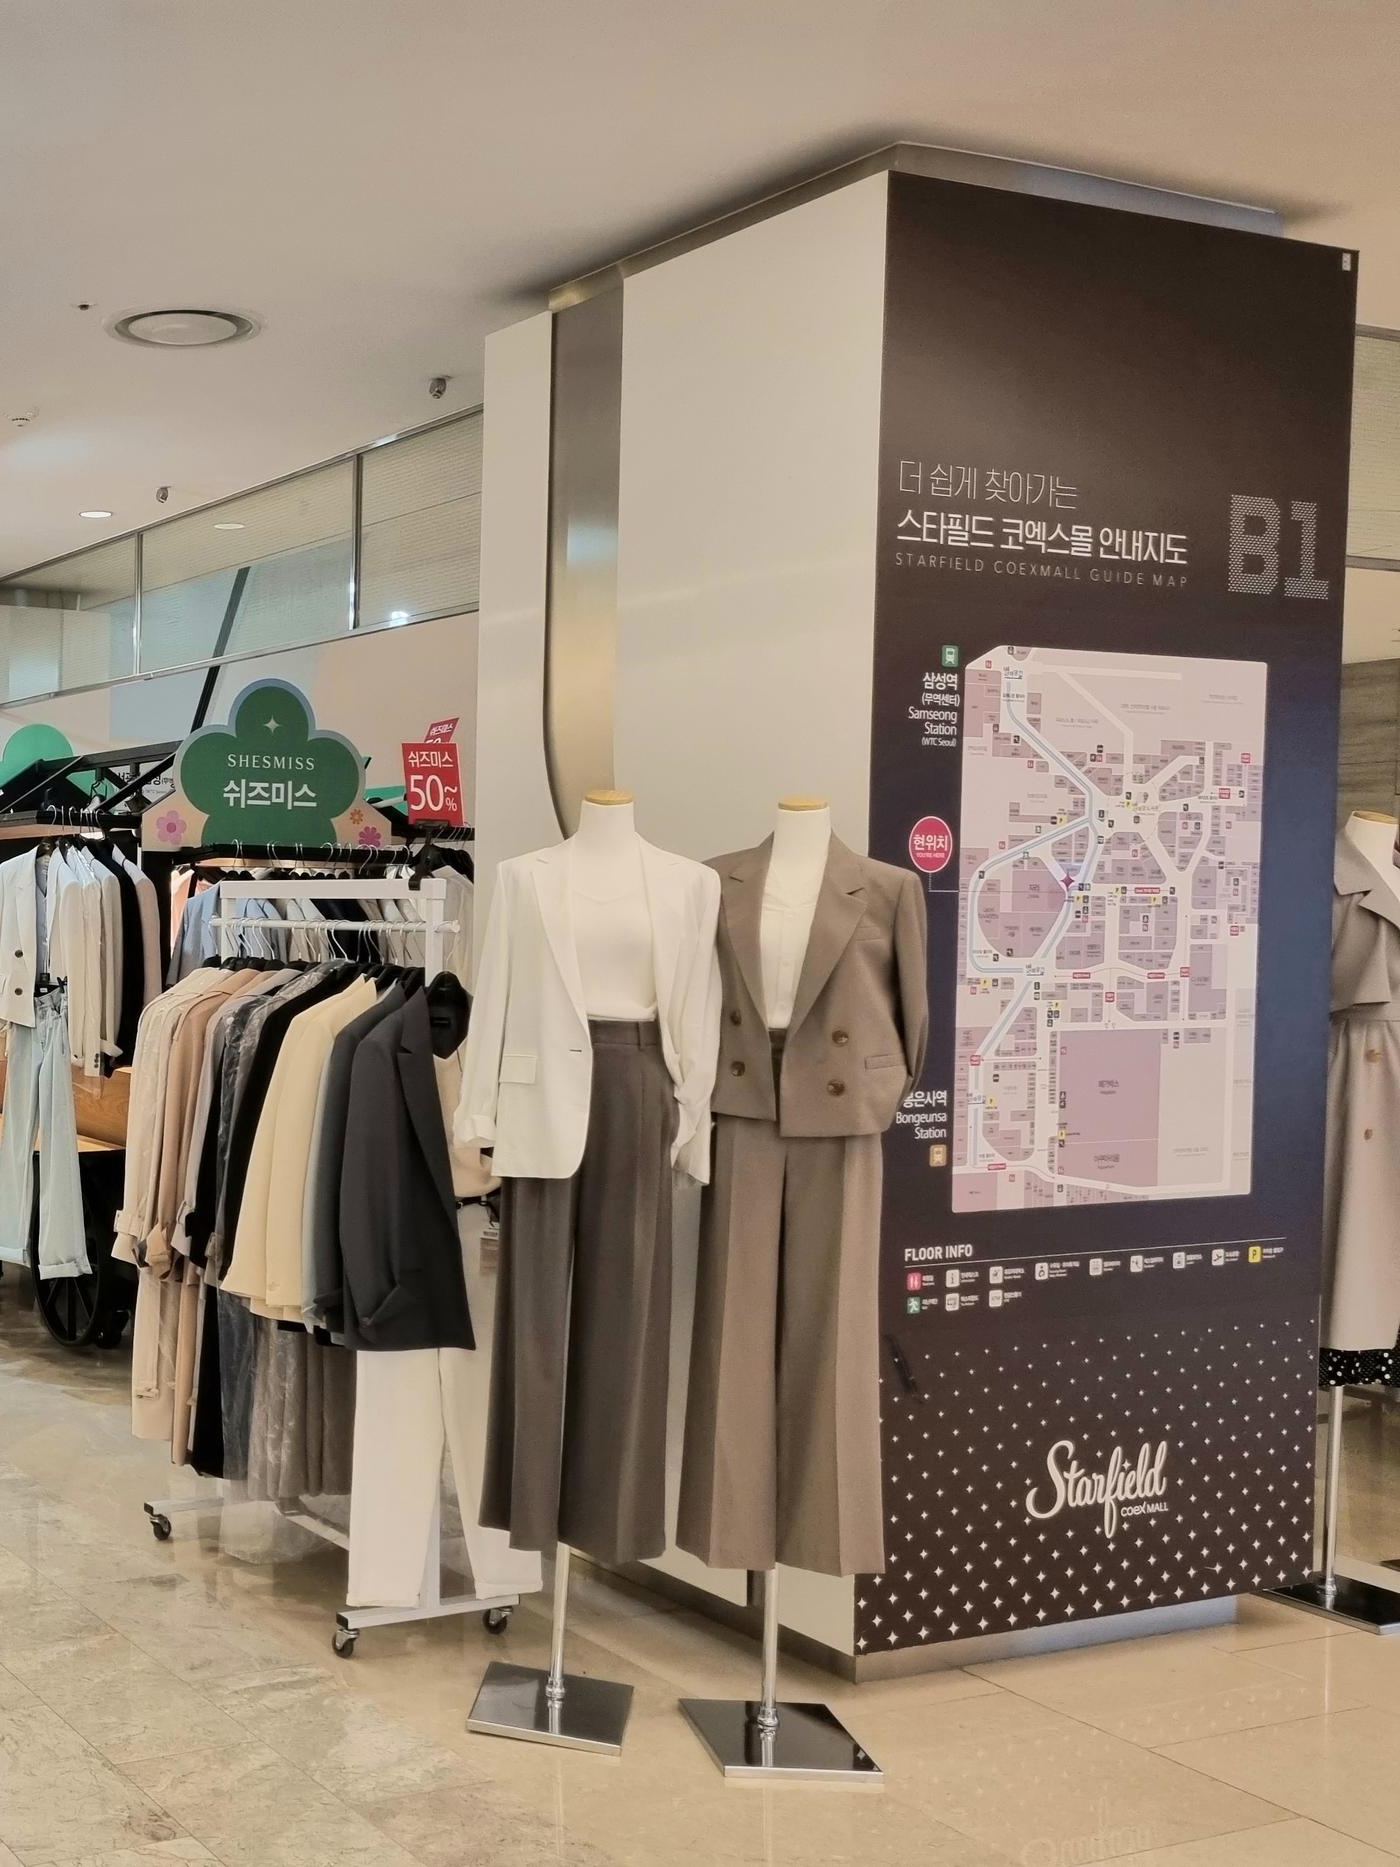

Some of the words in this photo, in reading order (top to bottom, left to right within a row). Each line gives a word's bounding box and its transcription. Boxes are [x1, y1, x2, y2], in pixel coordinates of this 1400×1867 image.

[899, 460, 922, 494] 더
[929, 464, 977, 500] 쉽게
[984, 467, 1078, 509] 찾아가는
[896, 509, 995, 548] 스타필드
[1000, 518, 1094, 558] 코엑스몰
[1099, 527, 1188, 565] 안내지도
[1227, 494, 1329, 600] B1
[895, 552, 985, 573] STARFIELD
[994, 560, 1081, 581] COEXMALL
[1089, 568, 1145, 586] GUIDE
[1152, 574, 1188, 588] MAP
[923, 672, 958, 691] 삼성역
[908, 706, 958, 724] Samseong
[924, 721, 957, 736] Station
[227, 753, 316, 772] SHESMISS
[408, 751, 454, 768] 쉬즈미스
[222, 779, 318, 811] 쉬즈미스
[913, 834, 948, 851] 현위치
[896, 1110, 947, 1127] Bongeunsa
[914, 1127, 947, 1140] Station
[904, 1246, 943, 1262] FLOOR
[945, 1244, 973, 1259] INFO
[1025, 1439, 1168, 1539] Starfield
